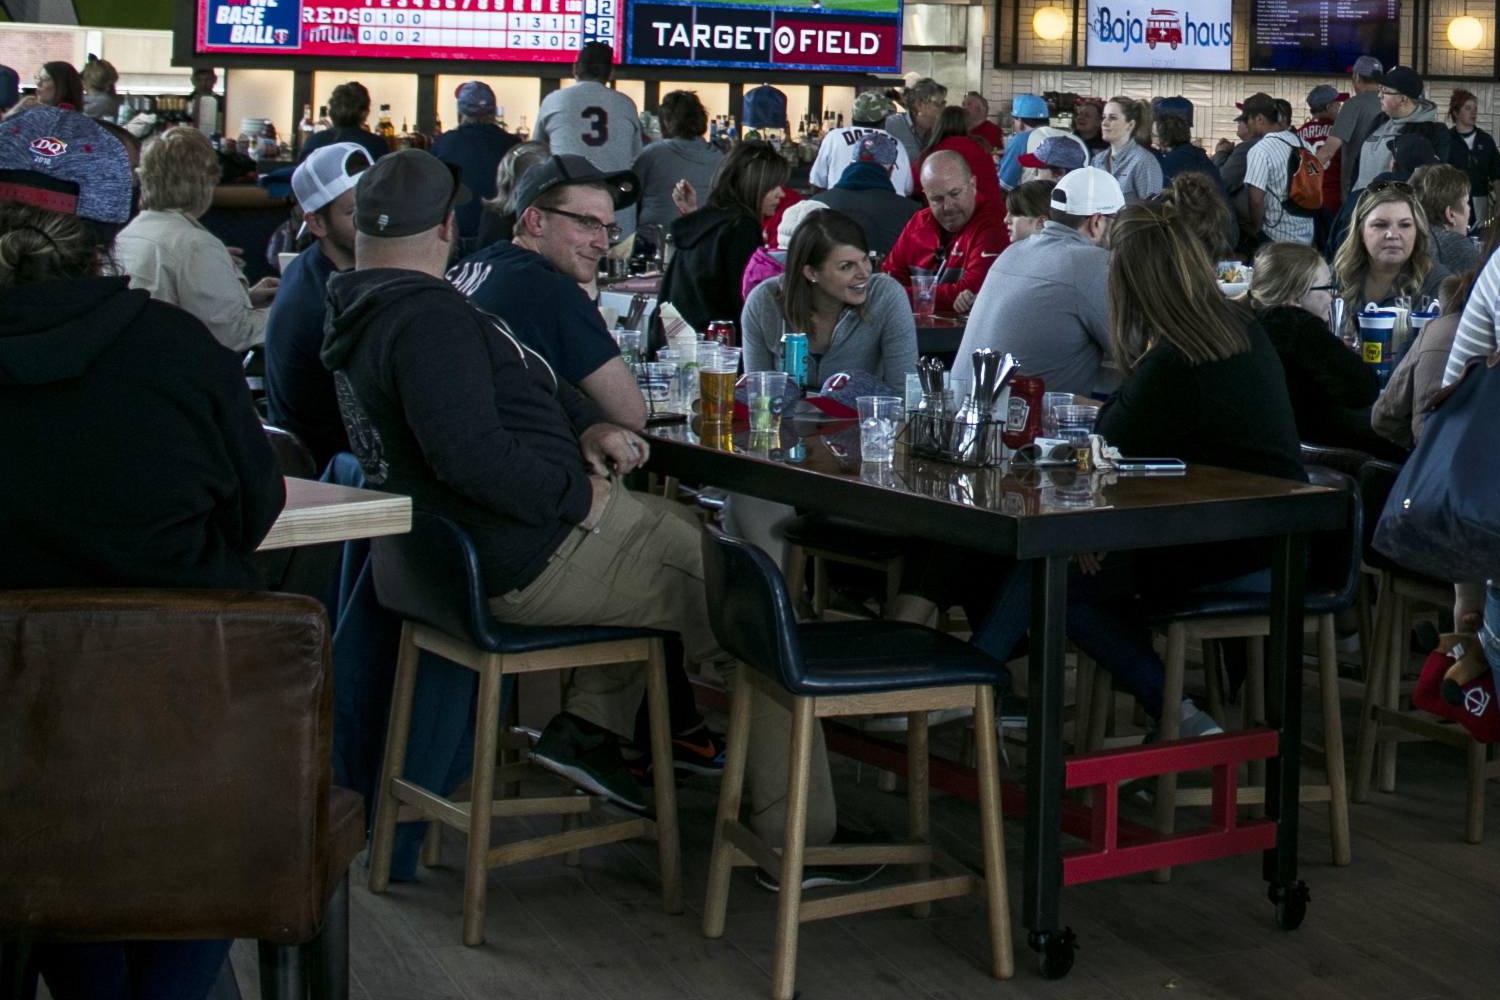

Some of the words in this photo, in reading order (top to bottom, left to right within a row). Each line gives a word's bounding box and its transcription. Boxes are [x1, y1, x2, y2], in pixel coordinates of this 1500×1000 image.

[215, 5, 266, 25] BASE
[302, 6, 359, 25] REDS
[230, 24, 276, 44] BALL
[652, 22, 772, 50] TARGET
[800, 29, 880, 54] FIELD
[1100, 6, 1143, 53] Baja
[1185, 11, 1231, 47] haus
[582, 106, 609, 148] 3
[36, 139, 60, 154] DQ
